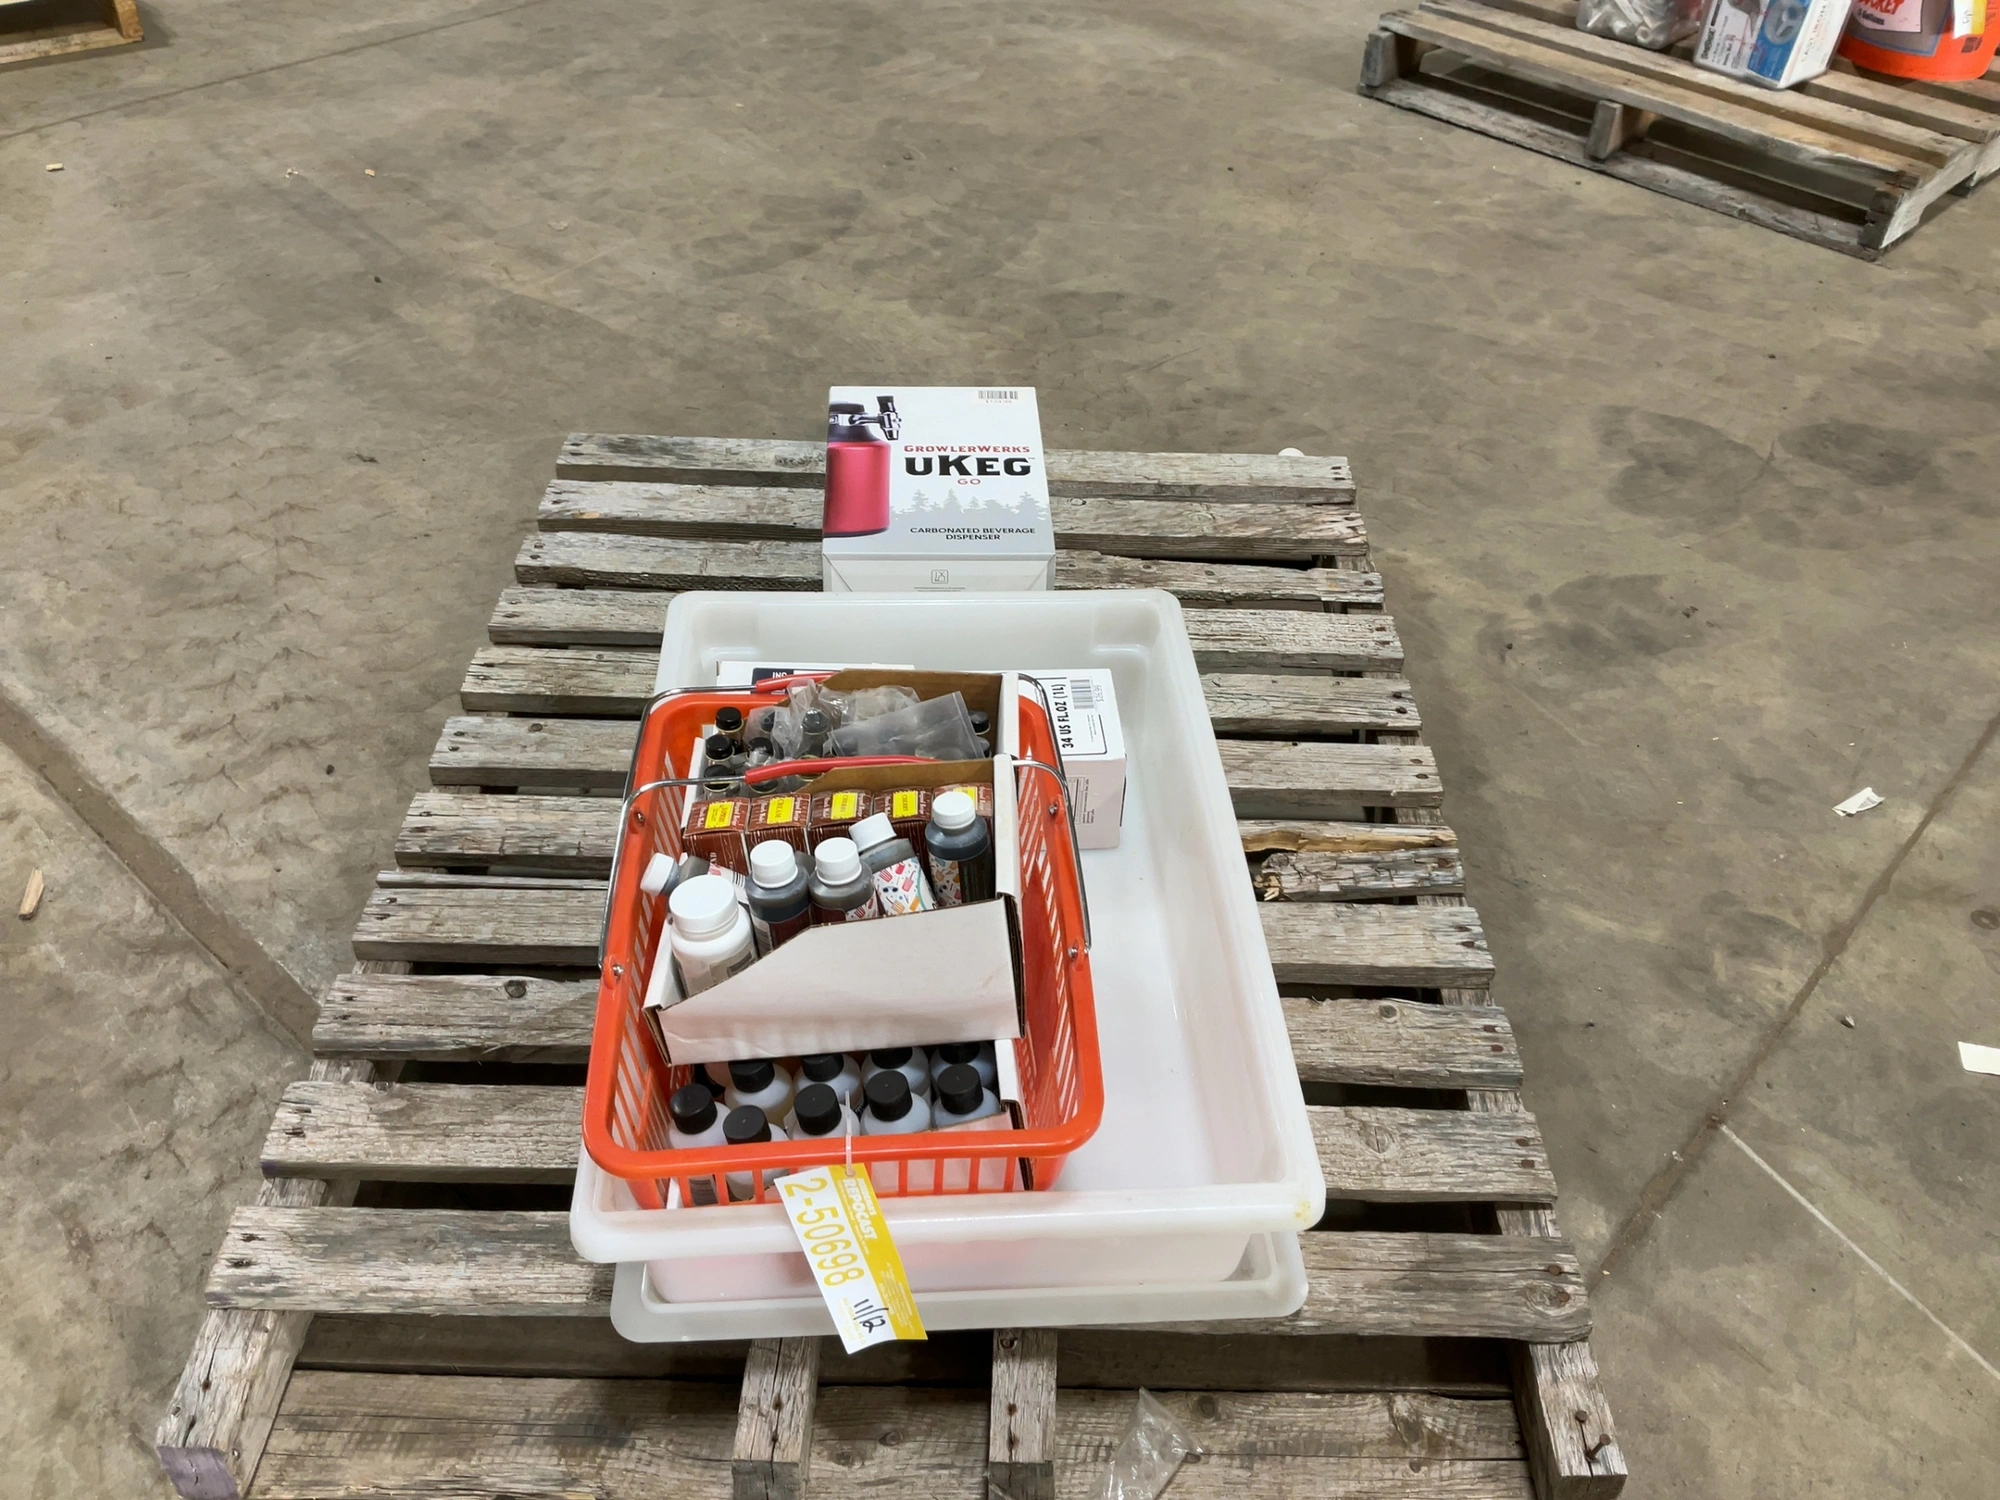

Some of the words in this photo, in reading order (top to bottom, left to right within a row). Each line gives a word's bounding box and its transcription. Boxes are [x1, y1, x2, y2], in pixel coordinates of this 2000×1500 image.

[904, 454, 1032, 476] UKEG
[1054, 701, 1070, 722] FL.OZ
[1058, 724, 1071, 735] US
[1060, 737, 1074, 749] 34
[775, 798, 784, 818] CREAM
[842, 1178, 878, 1240] REPOCAST
[783, 1177, 865, 1288] 2-50698
